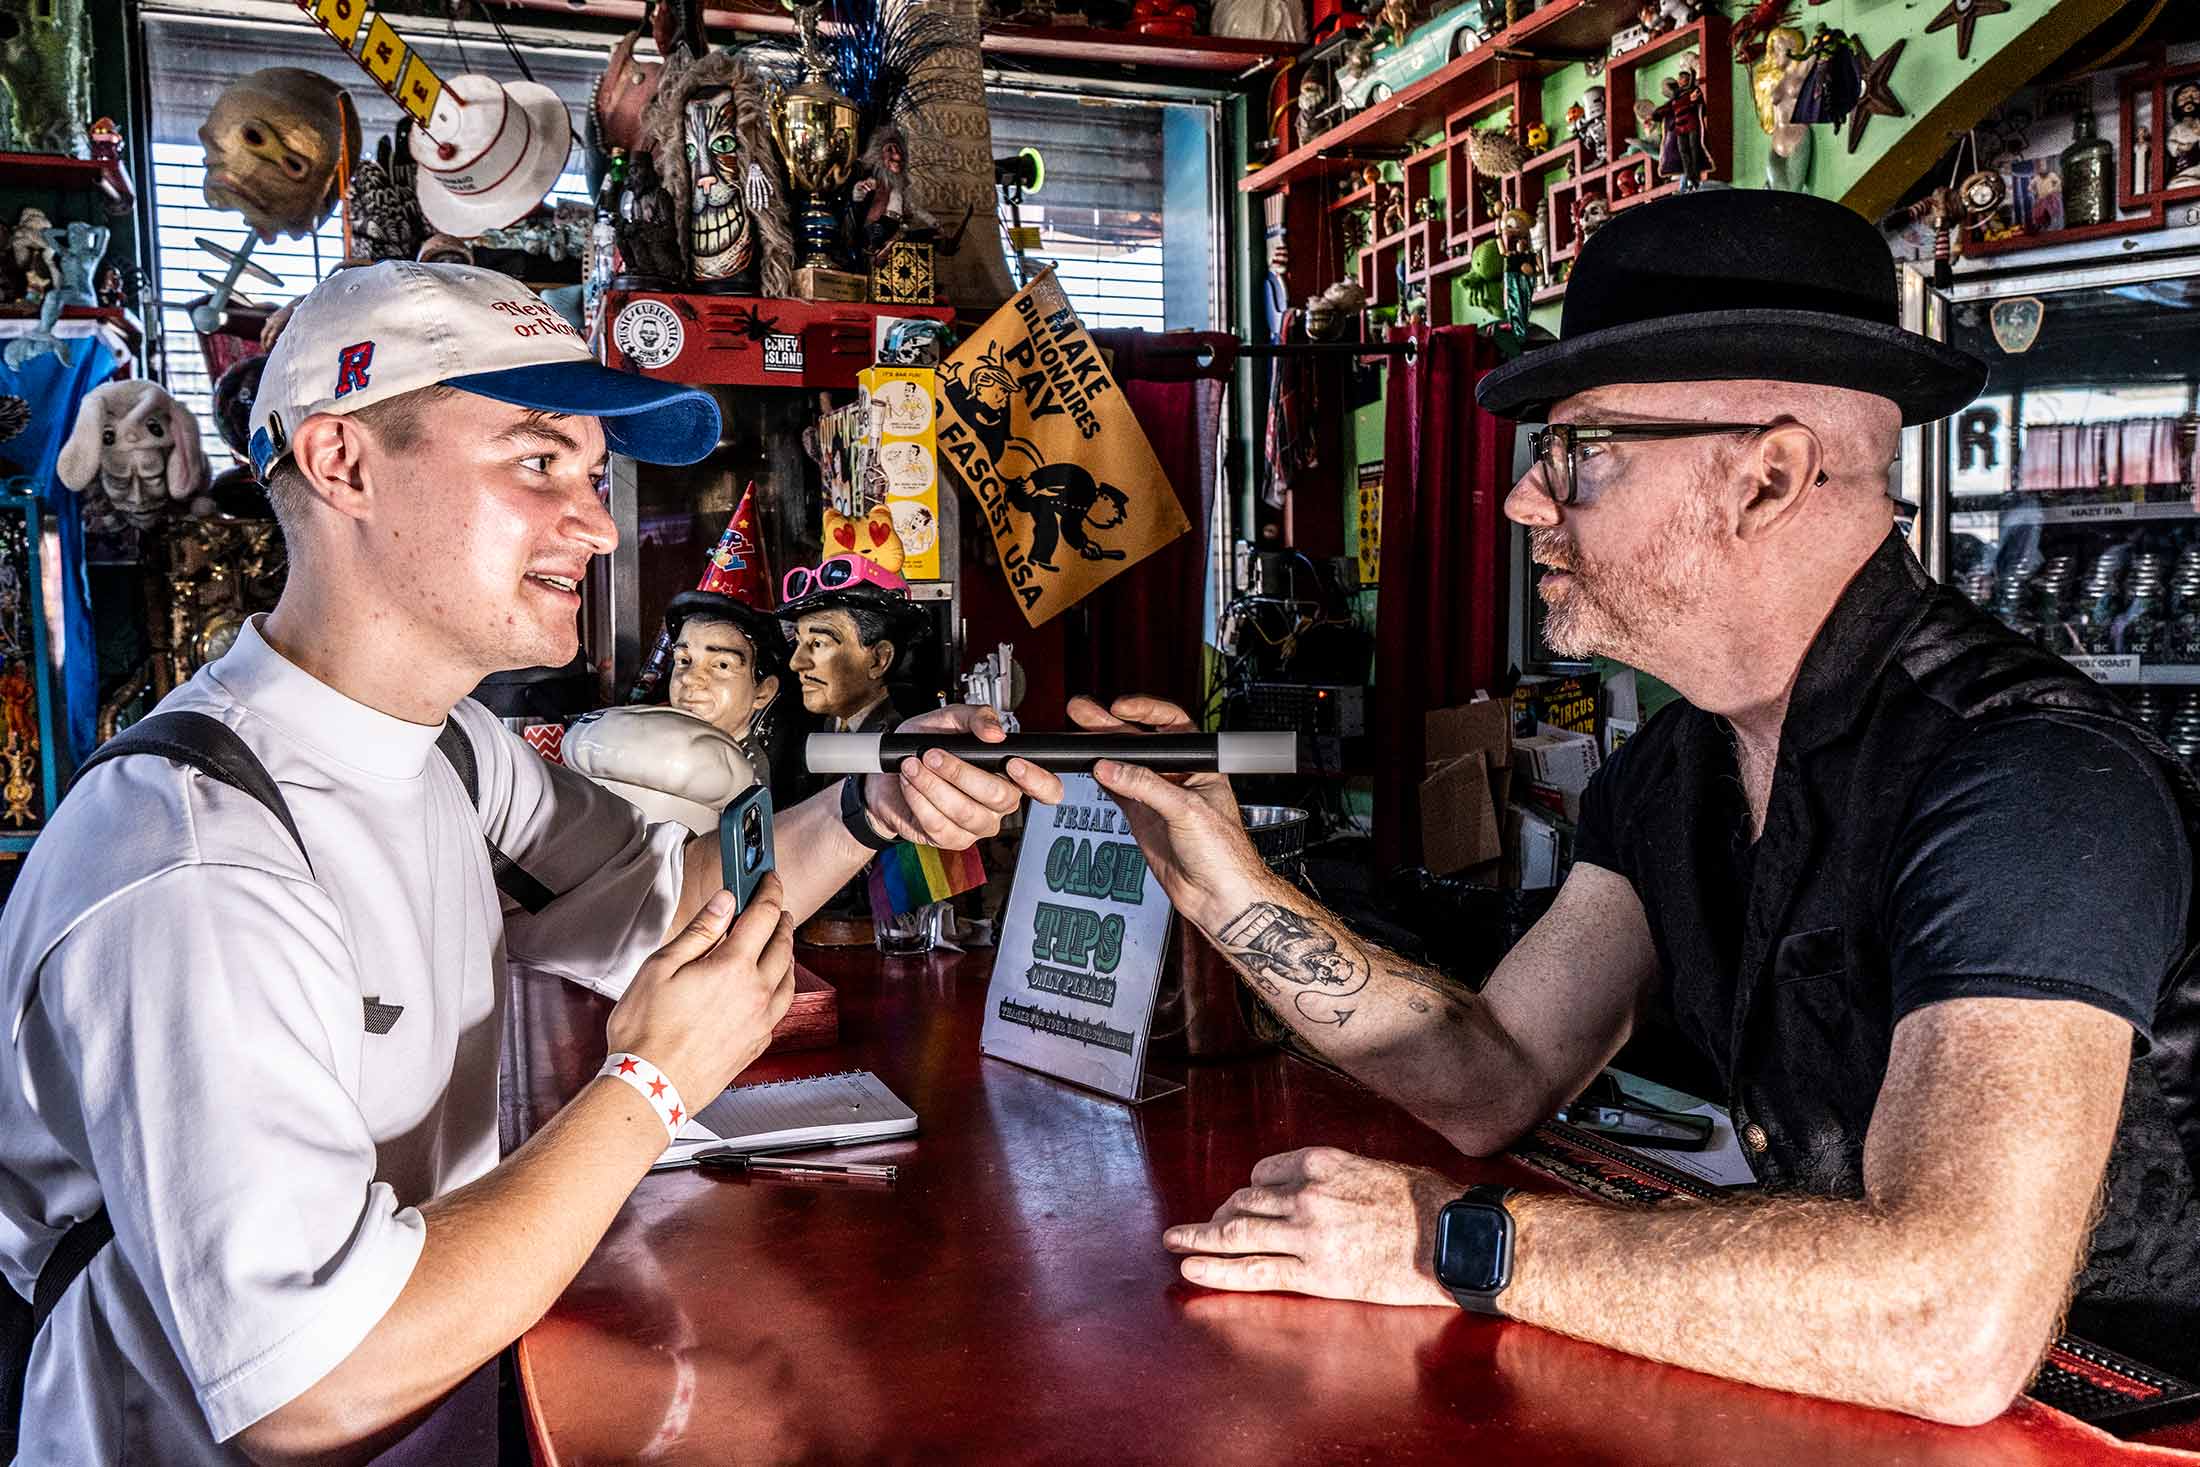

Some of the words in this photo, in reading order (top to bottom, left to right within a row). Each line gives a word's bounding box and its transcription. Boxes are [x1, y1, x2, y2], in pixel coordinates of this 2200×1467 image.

[514, 324, 540, 337] or
[535, 318, 579, 337] Now
[765, 337, 798, 352] CONEY
[335, 340, 376, 400] R
[765, 351, 803, 366] ISLAND
[1014, 295, 1101, 441] BILLIONAIRES
[1044, 307, 1111, 401] MAKE
[1004, 337, 1066, 421] PAY
[938, 420, 1014, 540] FASCIST
[1003, 543, 1044, 610] USA
[2071, 508, 2101, 517] HAZY
[2104, 506, 2122, 515] IPA
[1548, 697, 1594, 726] CIRCUS
[1053, 804, 1117, 834] FREAK
[1045, 836, 1147, 906] CASH
[1032, 901, 1126, 974] TIPS
[1032, 968, 1063, 992] ONLY
[1063, 974, 1114, 1003] PLEASE
